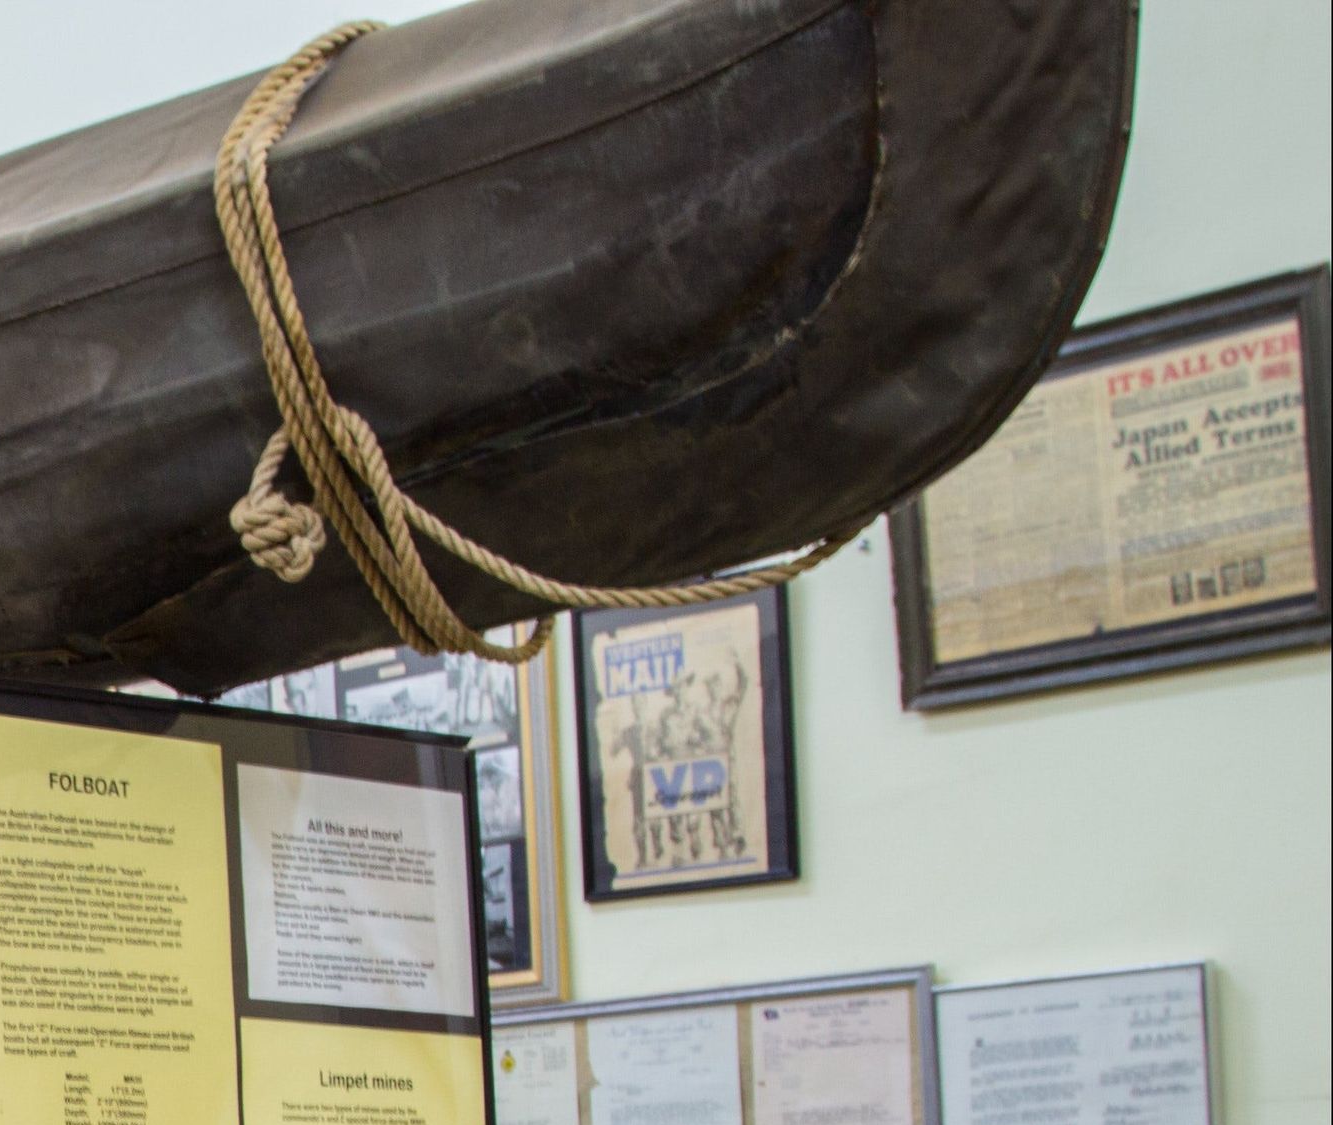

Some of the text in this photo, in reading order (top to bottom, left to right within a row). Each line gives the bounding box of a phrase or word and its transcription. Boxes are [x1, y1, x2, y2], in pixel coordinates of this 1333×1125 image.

[1163, 353, 1213, 382] ALL
[1112, 418, 1188, 448] Japan
[1125, 419, 1295, 471] Allied Terms
[49, 772, 130, 798] FOLBOAT
[308, 818, 403, 843] All this and more!
[320, 1070, 414, 1092] Limpet mines
